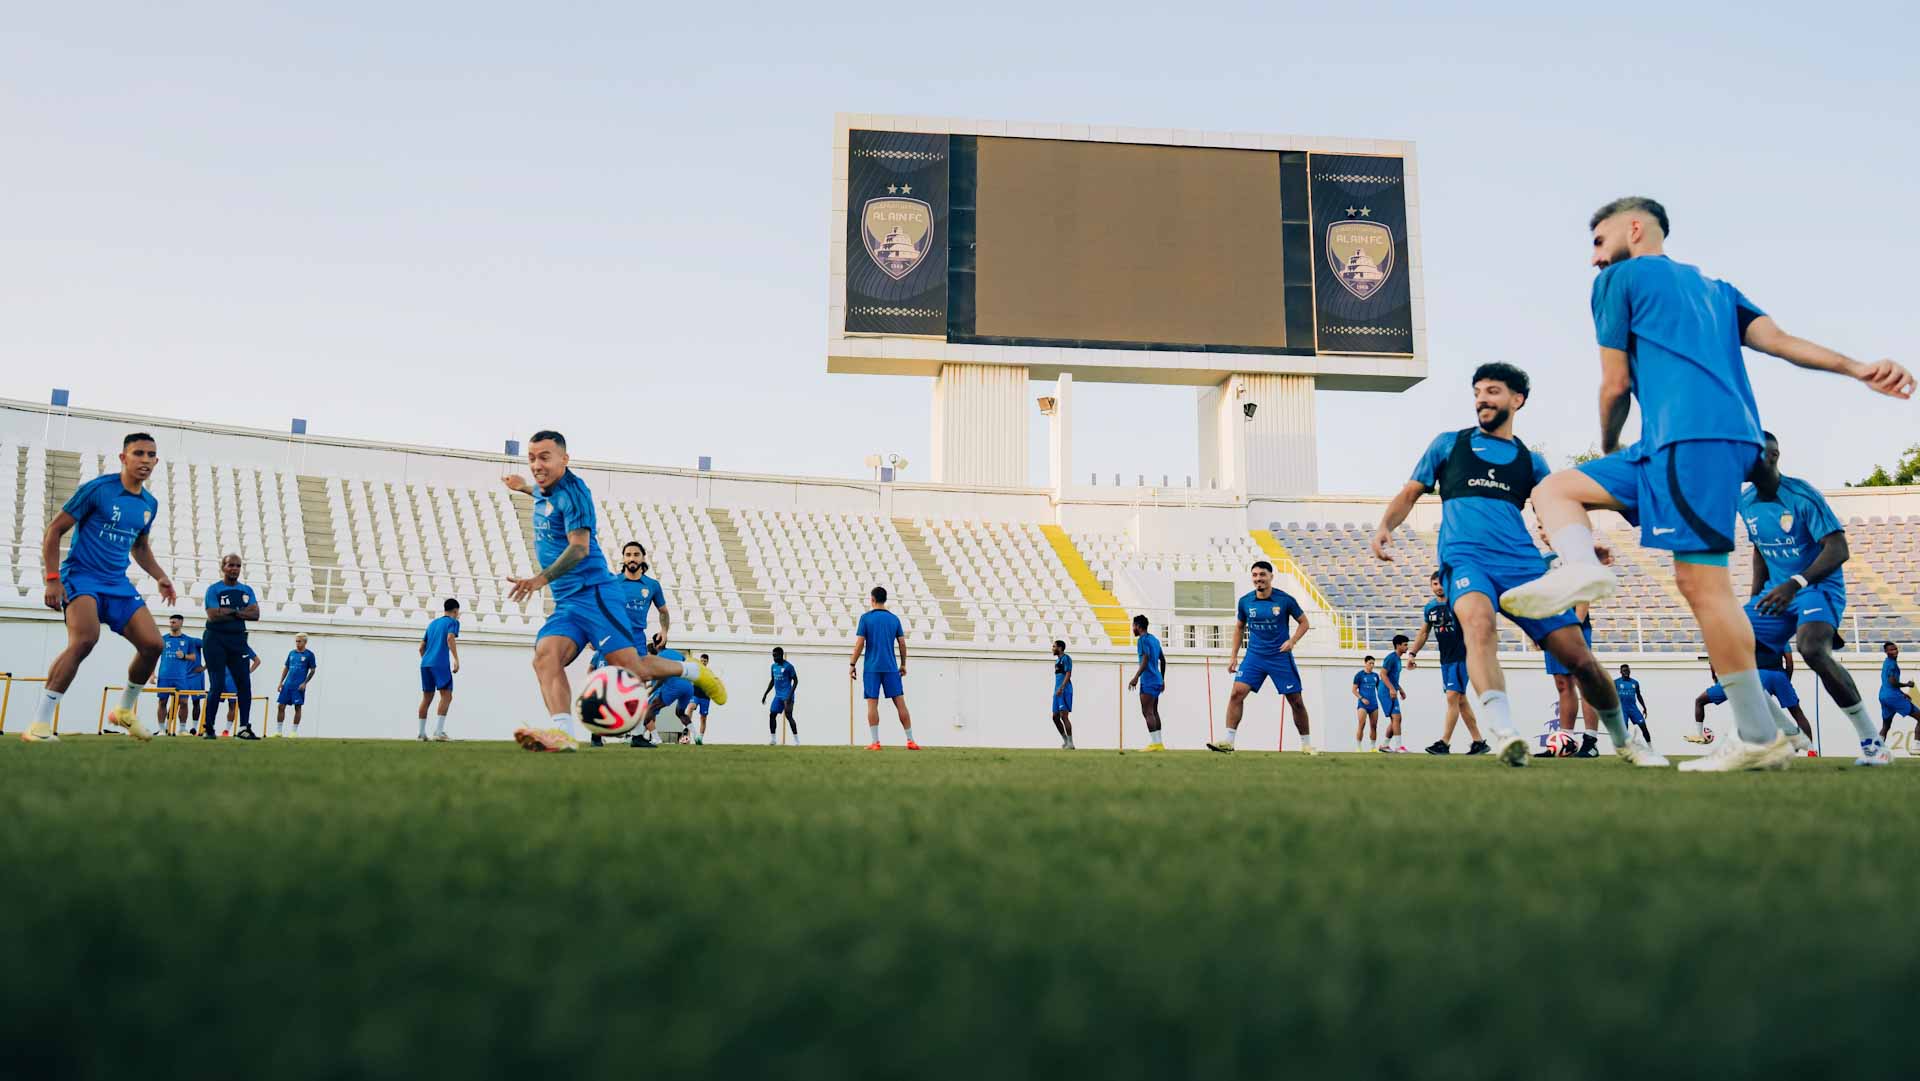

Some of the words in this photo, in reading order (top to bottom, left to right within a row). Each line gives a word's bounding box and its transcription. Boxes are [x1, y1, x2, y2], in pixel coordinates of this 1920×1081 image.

[872, 211, 887, 221] AL
[888, 212, 907, 221] AIN
[908, 213, 923, 222] FC
[1336, 234, 1349, 244] AL
[1351, 235, 1368, 244] AIN
[1369, 235, 1385, 245] FC
[111, 510, 122, 522] 21
